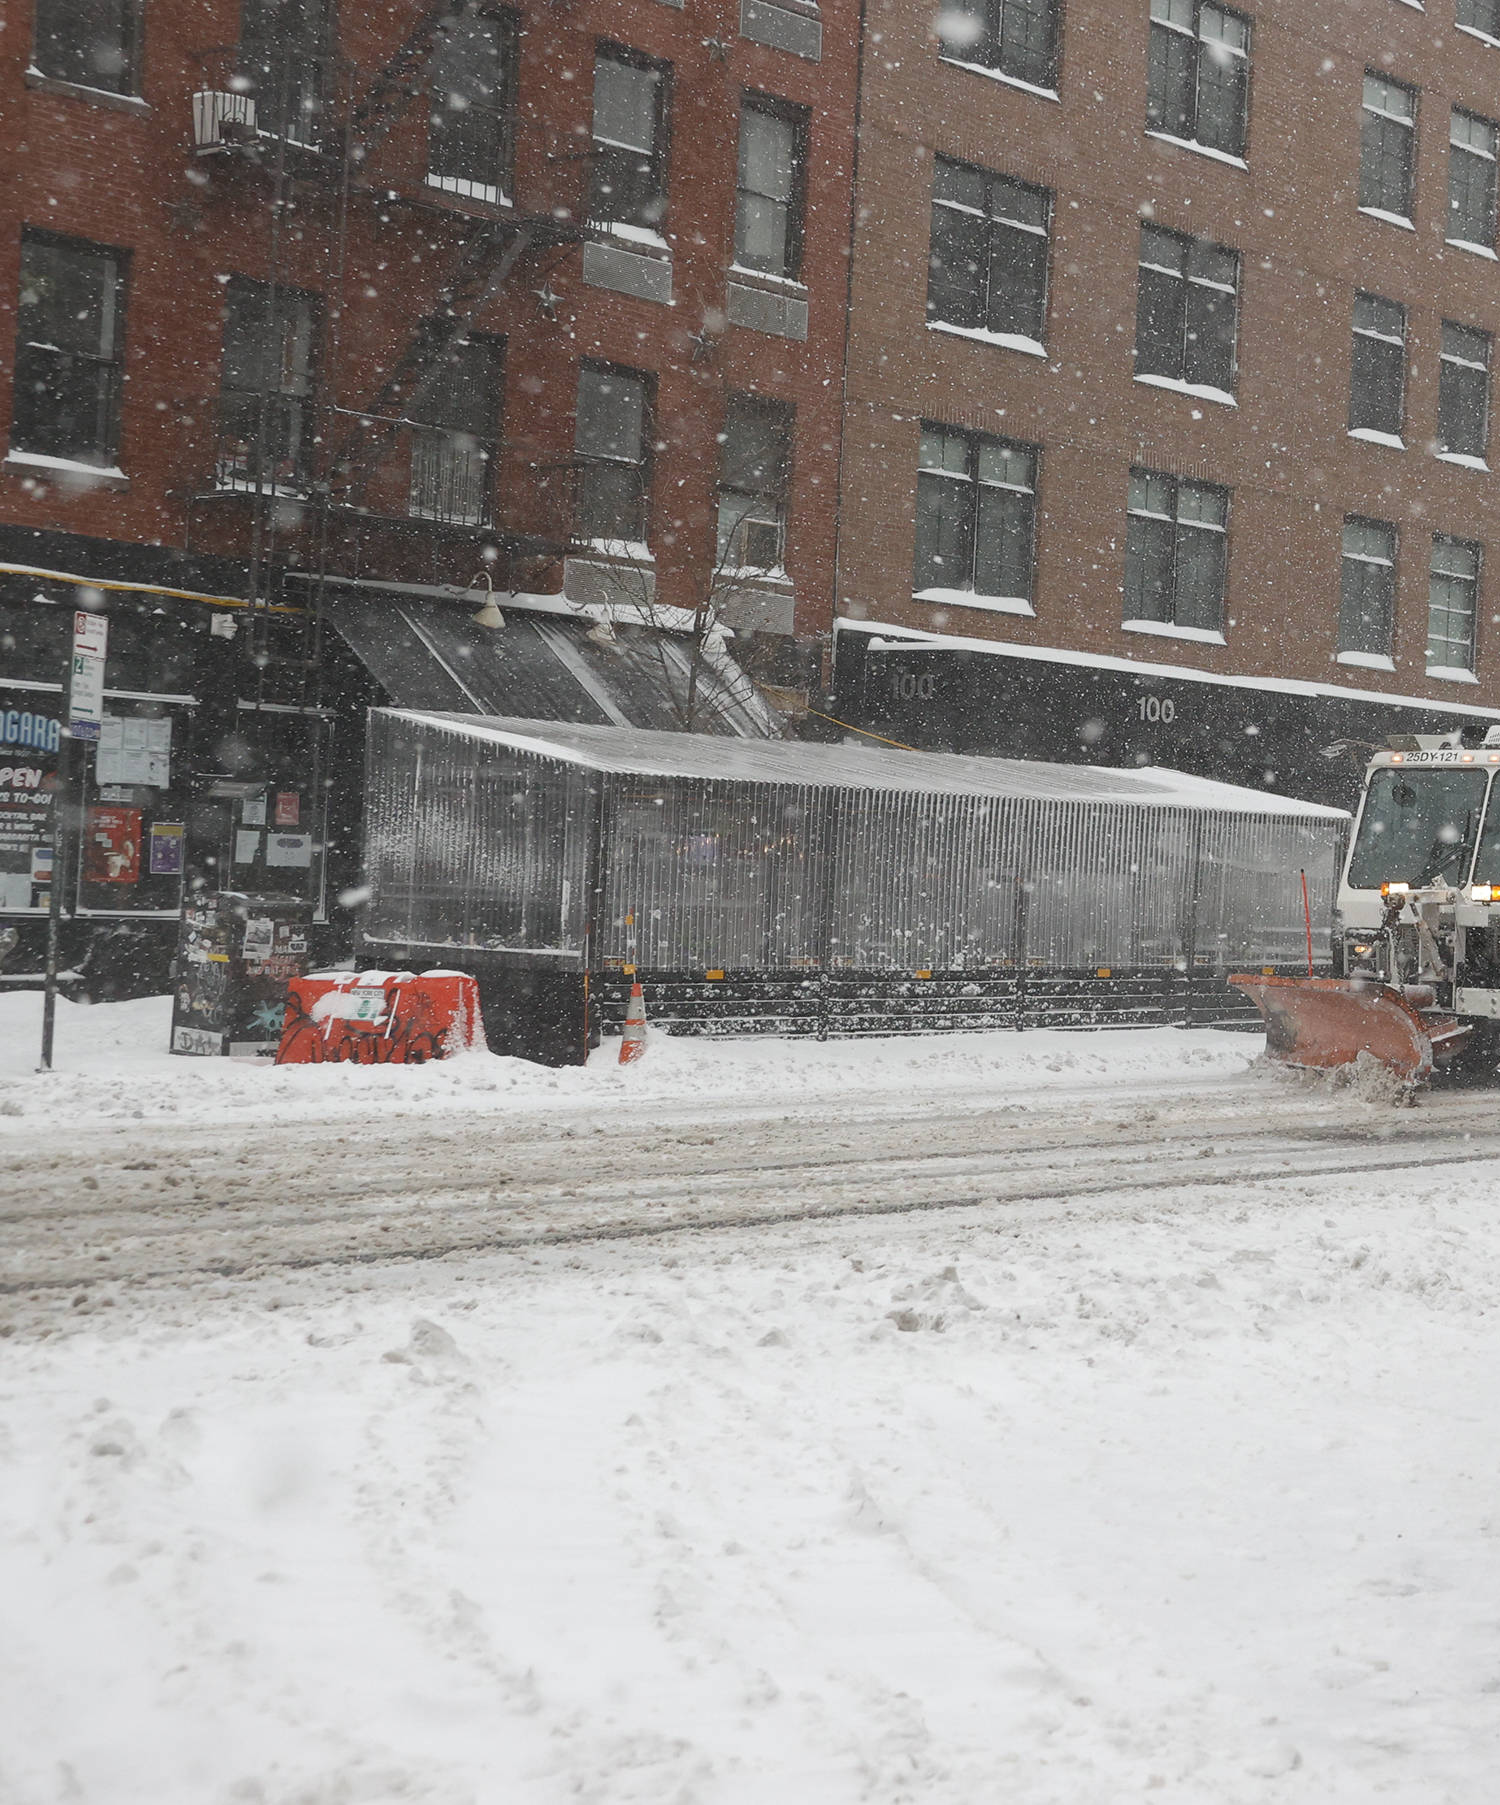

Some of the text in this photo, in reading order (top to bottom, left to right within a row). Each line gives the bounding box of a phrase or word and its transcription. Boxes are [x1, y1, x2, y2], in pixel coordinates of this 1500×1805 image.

[893, 675, 934, 701] 100
[1138, 696, 1174, 723] 100
[1406, 752, 1459, 762] 25DY-121
[13, 792, 53, 804] TO-GO!
